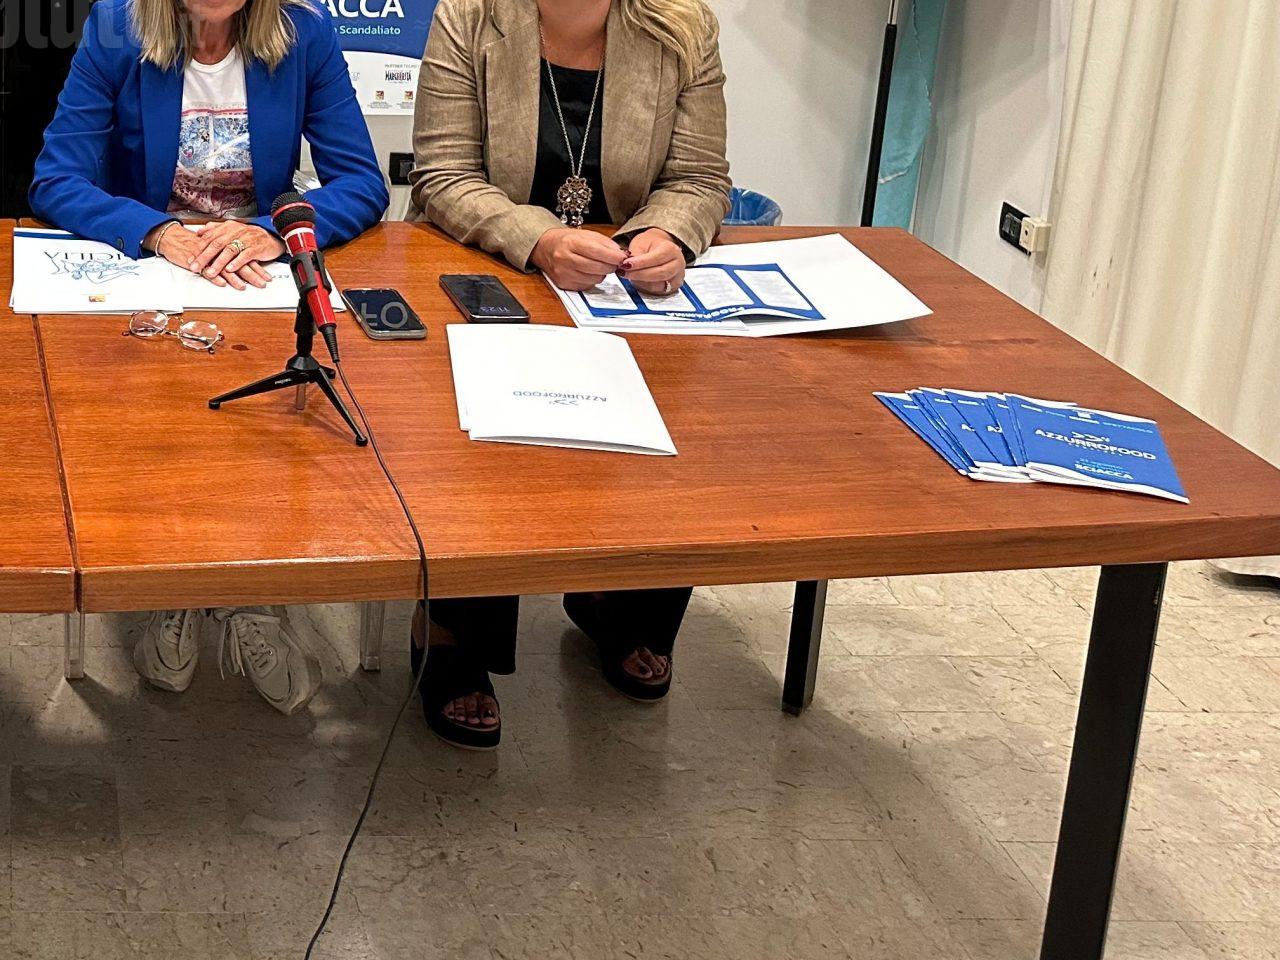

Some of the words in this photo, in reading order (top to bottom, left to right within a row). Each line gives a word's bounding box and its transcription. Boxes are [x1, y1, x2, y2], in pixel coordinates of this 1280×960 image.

[339, 25, 401, 36] Scandaliato
[512, 390, 607, 402] AZZURROFOOD
[1034, 428, 1157, 460] AZZURROFOOD
[1074, 463, 1134, 480] SCIACCA
